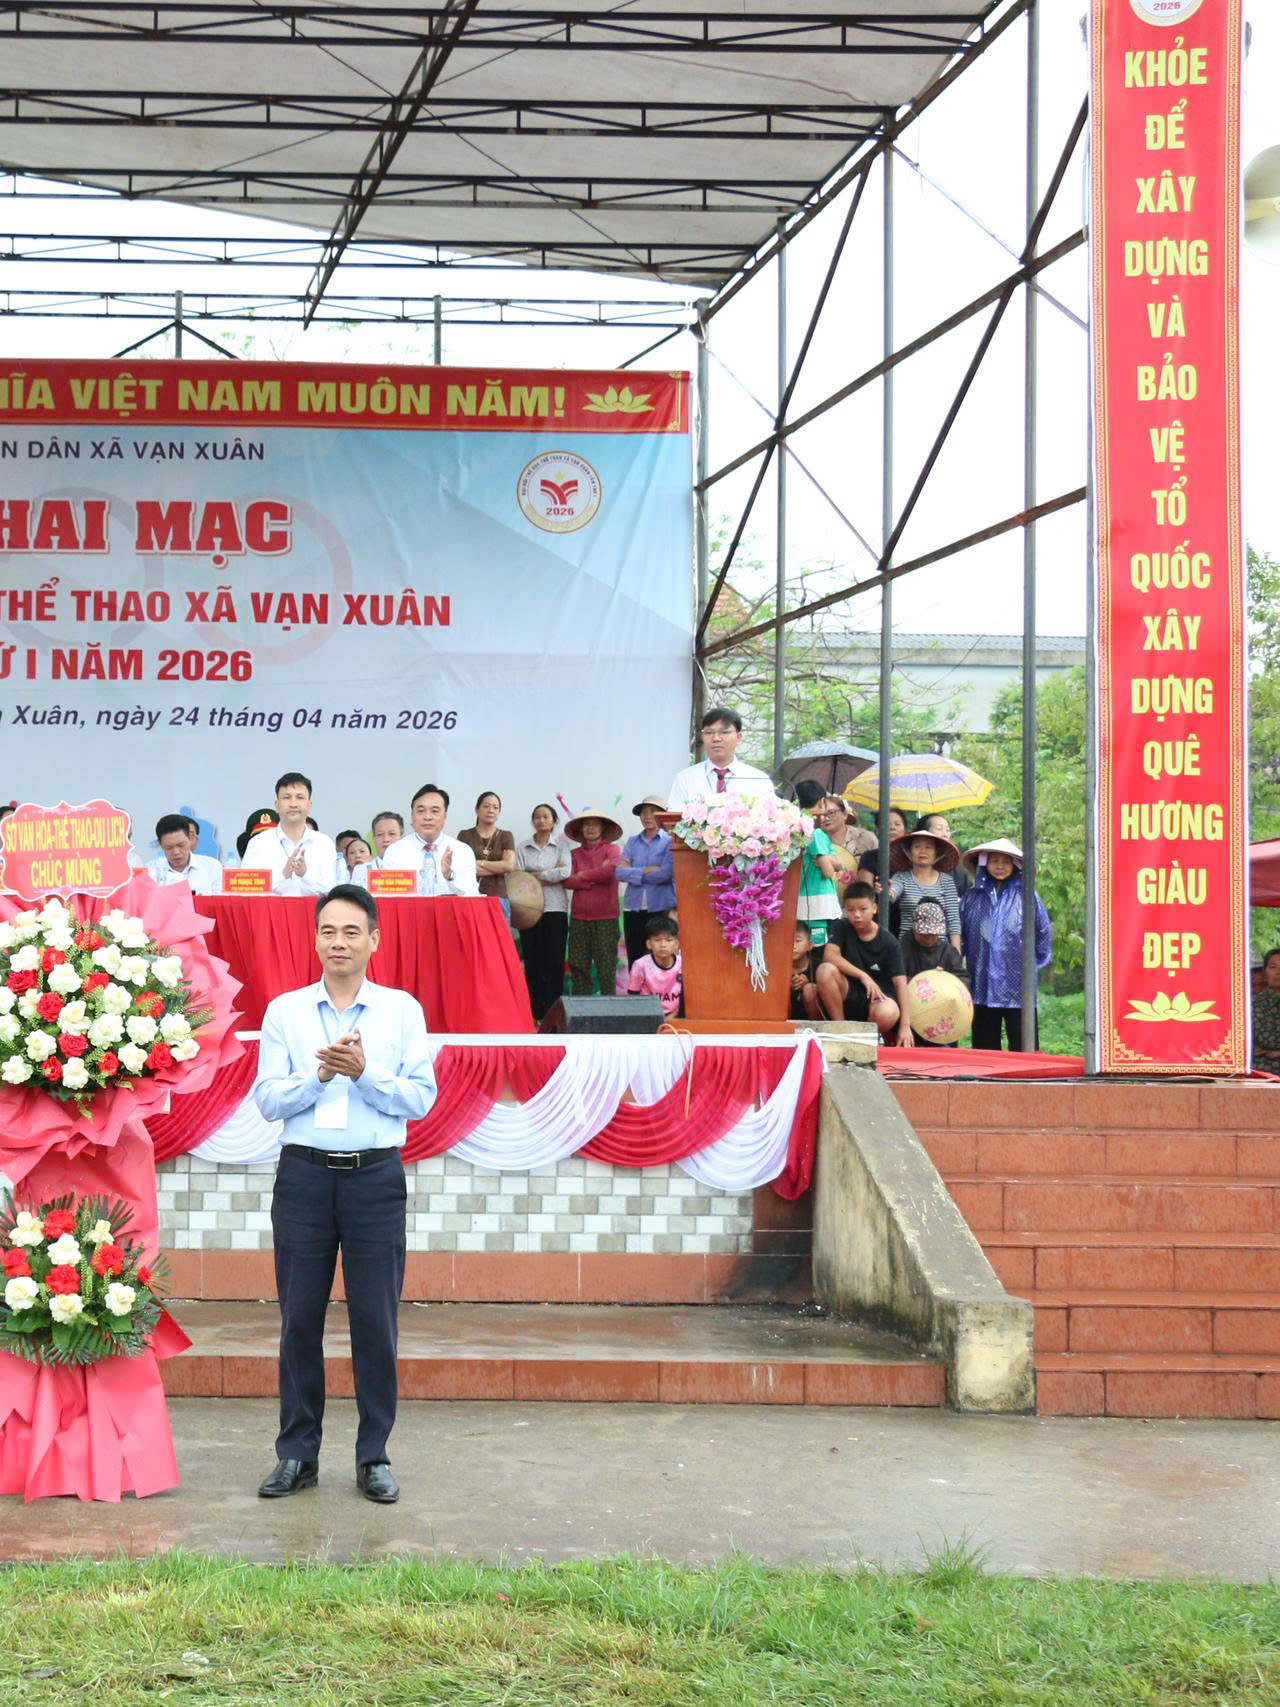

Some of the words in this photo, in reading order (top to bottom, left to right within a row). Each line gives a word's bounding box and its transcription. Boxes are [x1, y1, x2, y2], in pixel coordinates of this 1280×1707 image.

[1153, 2, 1181, 11] 2026
[1125, 37, 1208, 88] KHỎE
[1144, 98, 1187, 150] ĐỂ
[1136, 170, 1196, 213] XÂY
[1124, 237, 1209, 284] DỰNG
[1147, 295, 1186, 338] VÀ
[71, 372, 163, 416] VIỆT
[178, 379, 281, 412] NAM
[298, 374, 434, 415] MUÔN
[447, 375, 566, 418] NĂM!
[1137, 352, 1197, 401] BẢO
[27, 435, 81, 459] DÂN
[90, 436, 124, 460] XÃ
[132, 440, 185, 464] VẠN
[194, 437, 265, 461] XUÂN
[1150, 420, 1186, 471] VỆ
[546, 507, 574, 515] 2026
[1151, 476, 1187, 527] TỔ
[135, 500, 290, 567] MẠC
[1130, 541, 1211, 593] QUỐC
[71, 590, 170, 623] THAO
[186, 588, 237, 623] XÃ
[251, 591, 329, 631] VẠN
[343, 588, 451, 626] XUÂN
[1143, 609, 1201, 651] XÂY
[27, 649, 36, 680] I
[52, 642, 143, 681] NĂM
[158, 649, 253, 682] 2026
[11, 704, 86, 729] Xuân,
[96, 704, 162, 731] ngày
[168, 706, 200, 726] 24
[209, 705, 284, 733] tháng
[292, 708, 323, 728] 04
[331, 707, 387, 729] năm
[395, 710, 458, 730] 2026
[1131, 675, 1213, 723] DỰNG
[1143, 734, 1201, 780] QUÊ
[1120, 799, 1224, 842] HƯƠNG
[31, 853, 63, 888] CHÚC
[65, 852, 102, 886] MỪNG
[1136, 860, 1207, 905] GIÀU
[1142, 932, 1201, 977] ĐẸP
